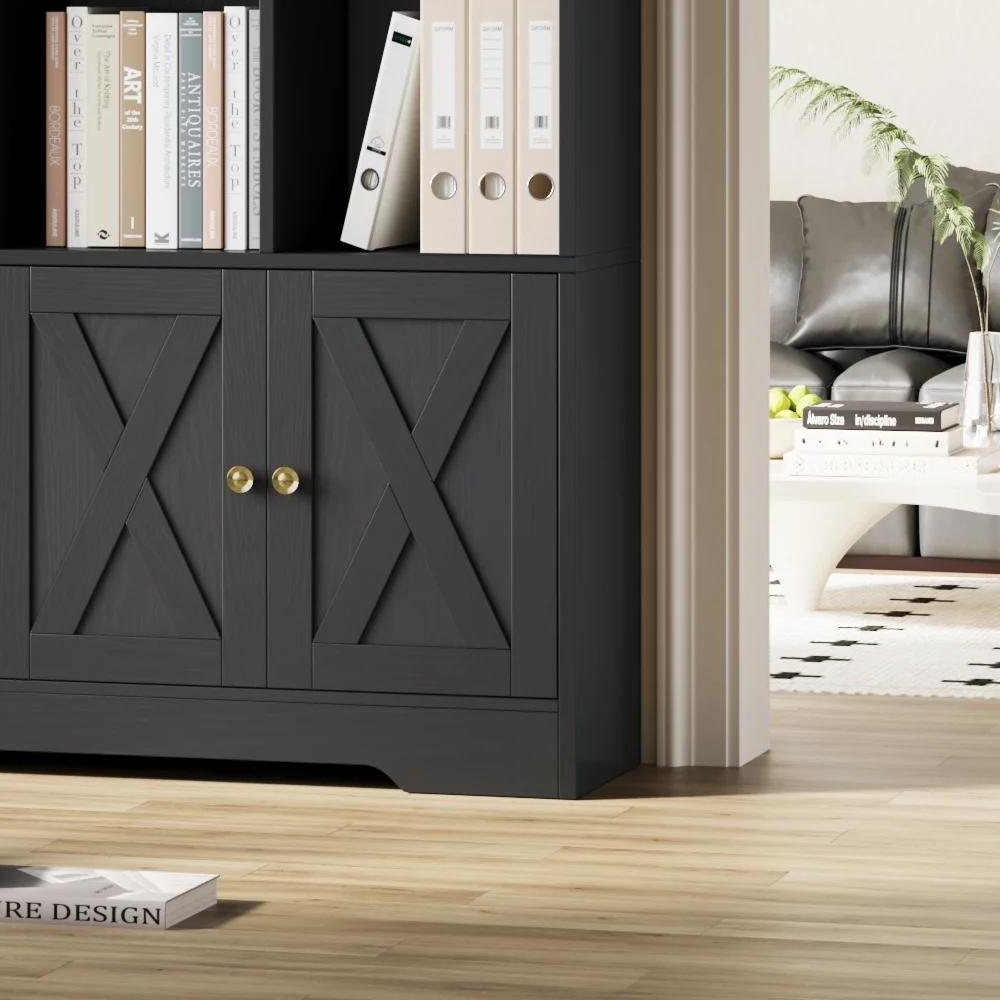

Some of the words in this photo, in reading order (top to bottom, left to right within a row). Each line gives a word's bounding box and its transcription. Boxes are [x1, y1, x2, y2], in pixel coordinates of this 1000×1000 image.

[122, 66, 143, 104] ART
[49, 105, 61, 166] BORDEAUX
[187, 72, 201, 188] ANTIQUAIRES
[206, 106, 218, 168] BORDEAUX
[52, 902, 163, 926] DESIGN
